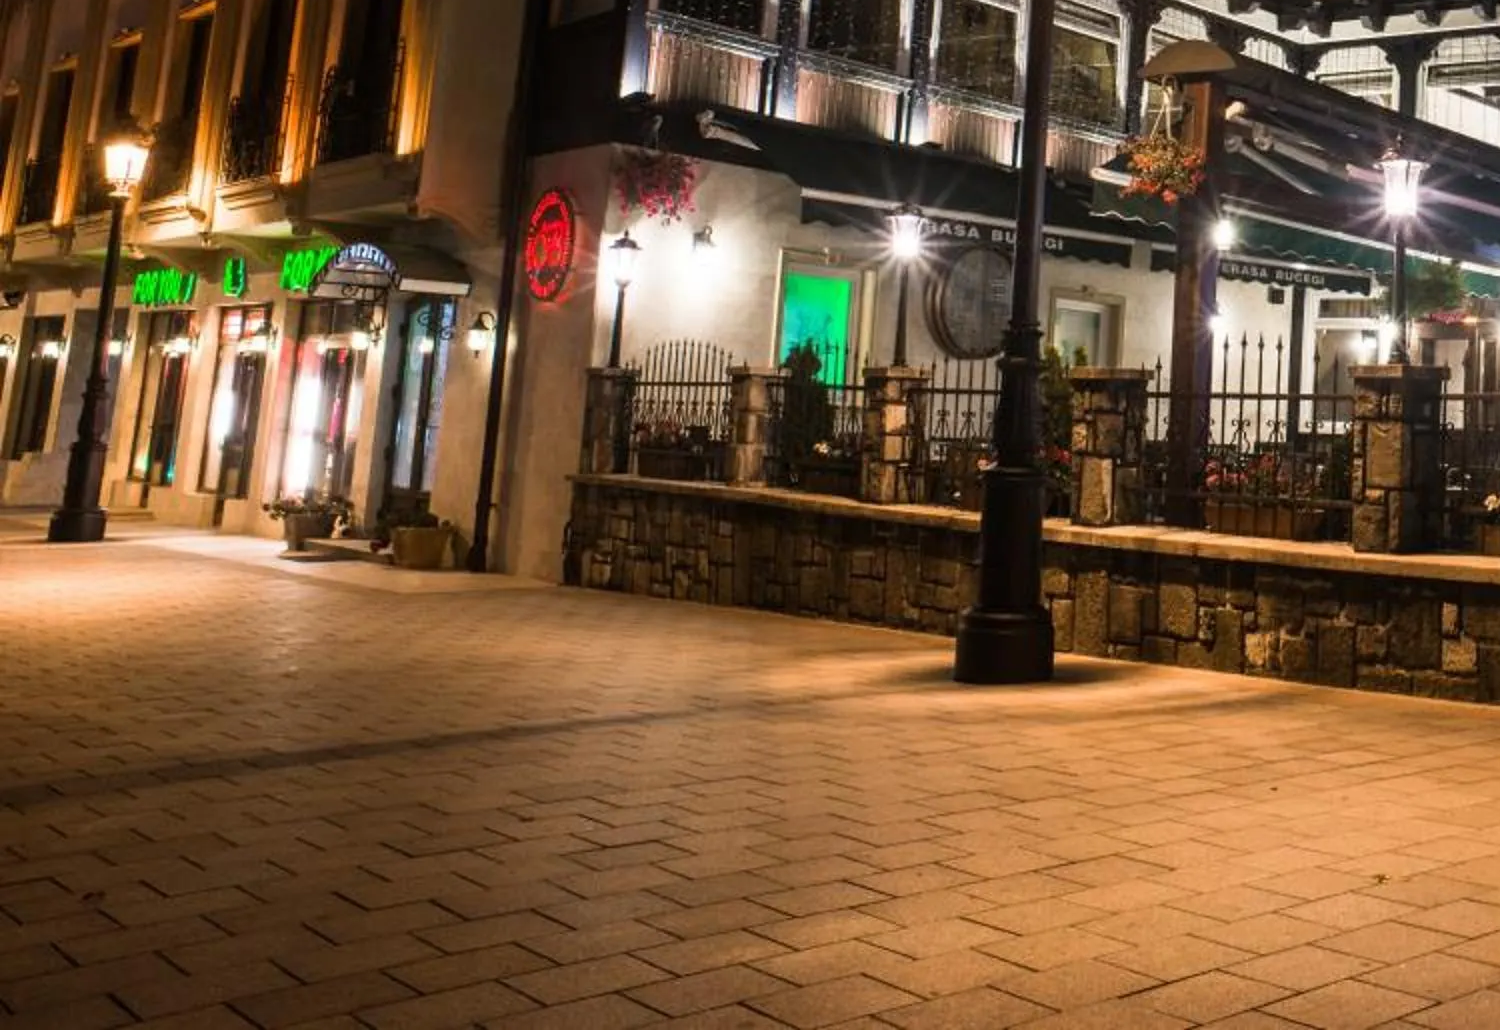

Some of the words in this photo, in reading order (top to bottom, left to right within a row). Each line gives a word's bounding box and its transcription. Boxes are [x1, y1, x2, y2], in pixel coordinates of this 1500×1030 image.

[912, 219, 981, 239] RASA
[992, 228, 1064, 251] BUGI
[1219, 262, 1268, 279] ERASA
